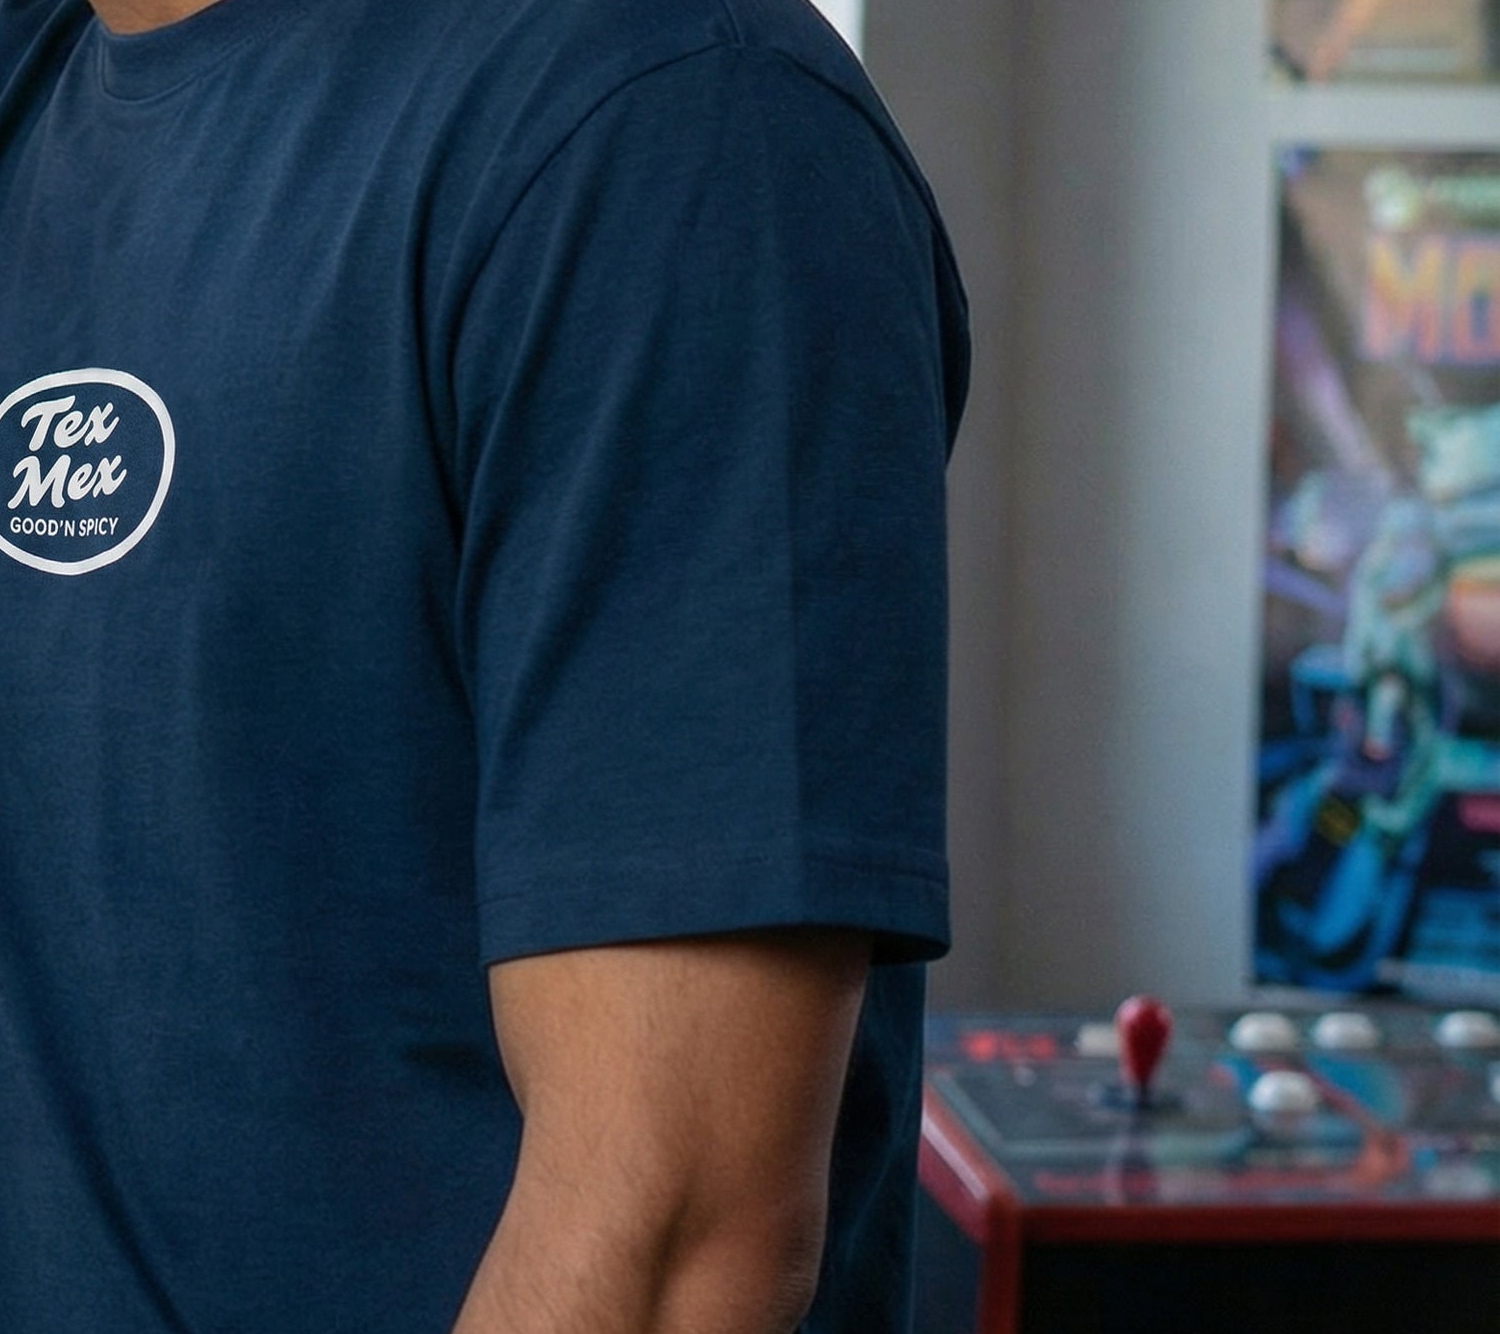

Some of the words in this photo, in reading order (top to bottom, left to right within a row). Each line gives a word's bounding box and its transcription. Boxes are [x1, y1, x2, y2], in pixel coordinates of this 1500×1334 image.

[21, 395, 120, 452] Tex
[7, 454, 128, 510] Mex
[78, 516, 120, 537] SPICY
